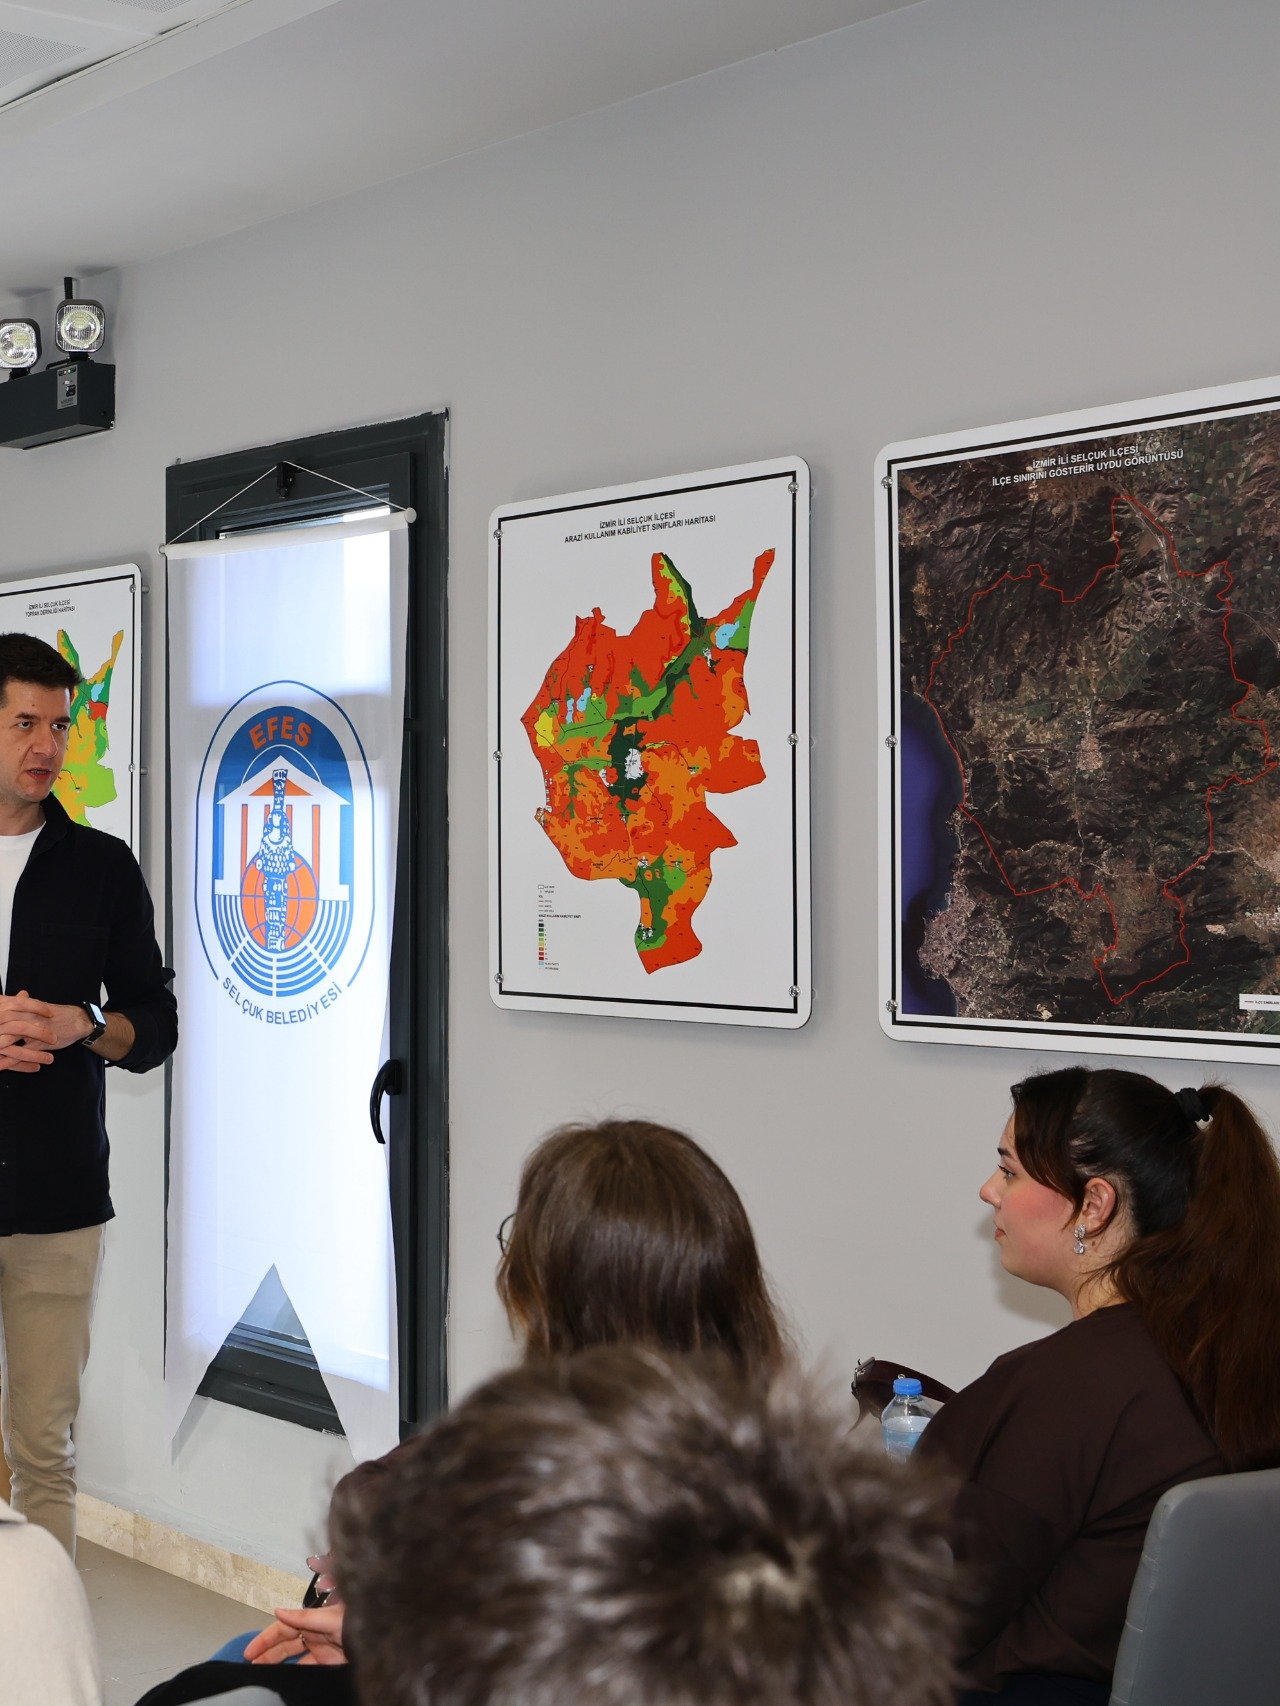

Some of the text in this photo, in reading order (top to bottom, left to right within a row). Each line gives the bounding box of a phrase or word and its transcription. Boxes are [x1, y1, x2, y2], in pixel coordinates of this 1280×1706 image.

[992, 448, 1184, 487] İLÇE SINIRINI GÖSTERİR UYDU GÖRÜNTÜSÜ
[1032, 444, 1139, 469] İZMİR İLİ SELÇUK İLÇESİ
[564, 534, 583, 543] ARAZİ
[584, 529, 616, 541] KULLANIM
[617, 524, 651, 537] KABİLİYET
[652, 519, 684, 531] SINIFLARI
[599, 519, 617, 529] İZMİR
[627, 514, 653, 526] SELÇUK
[653, 510, 675, 521] İLÇESİ
[249, 715, 313, 750] EFES
[223, 977, 342, 1024] SELÇUK BELEDİYESİ
